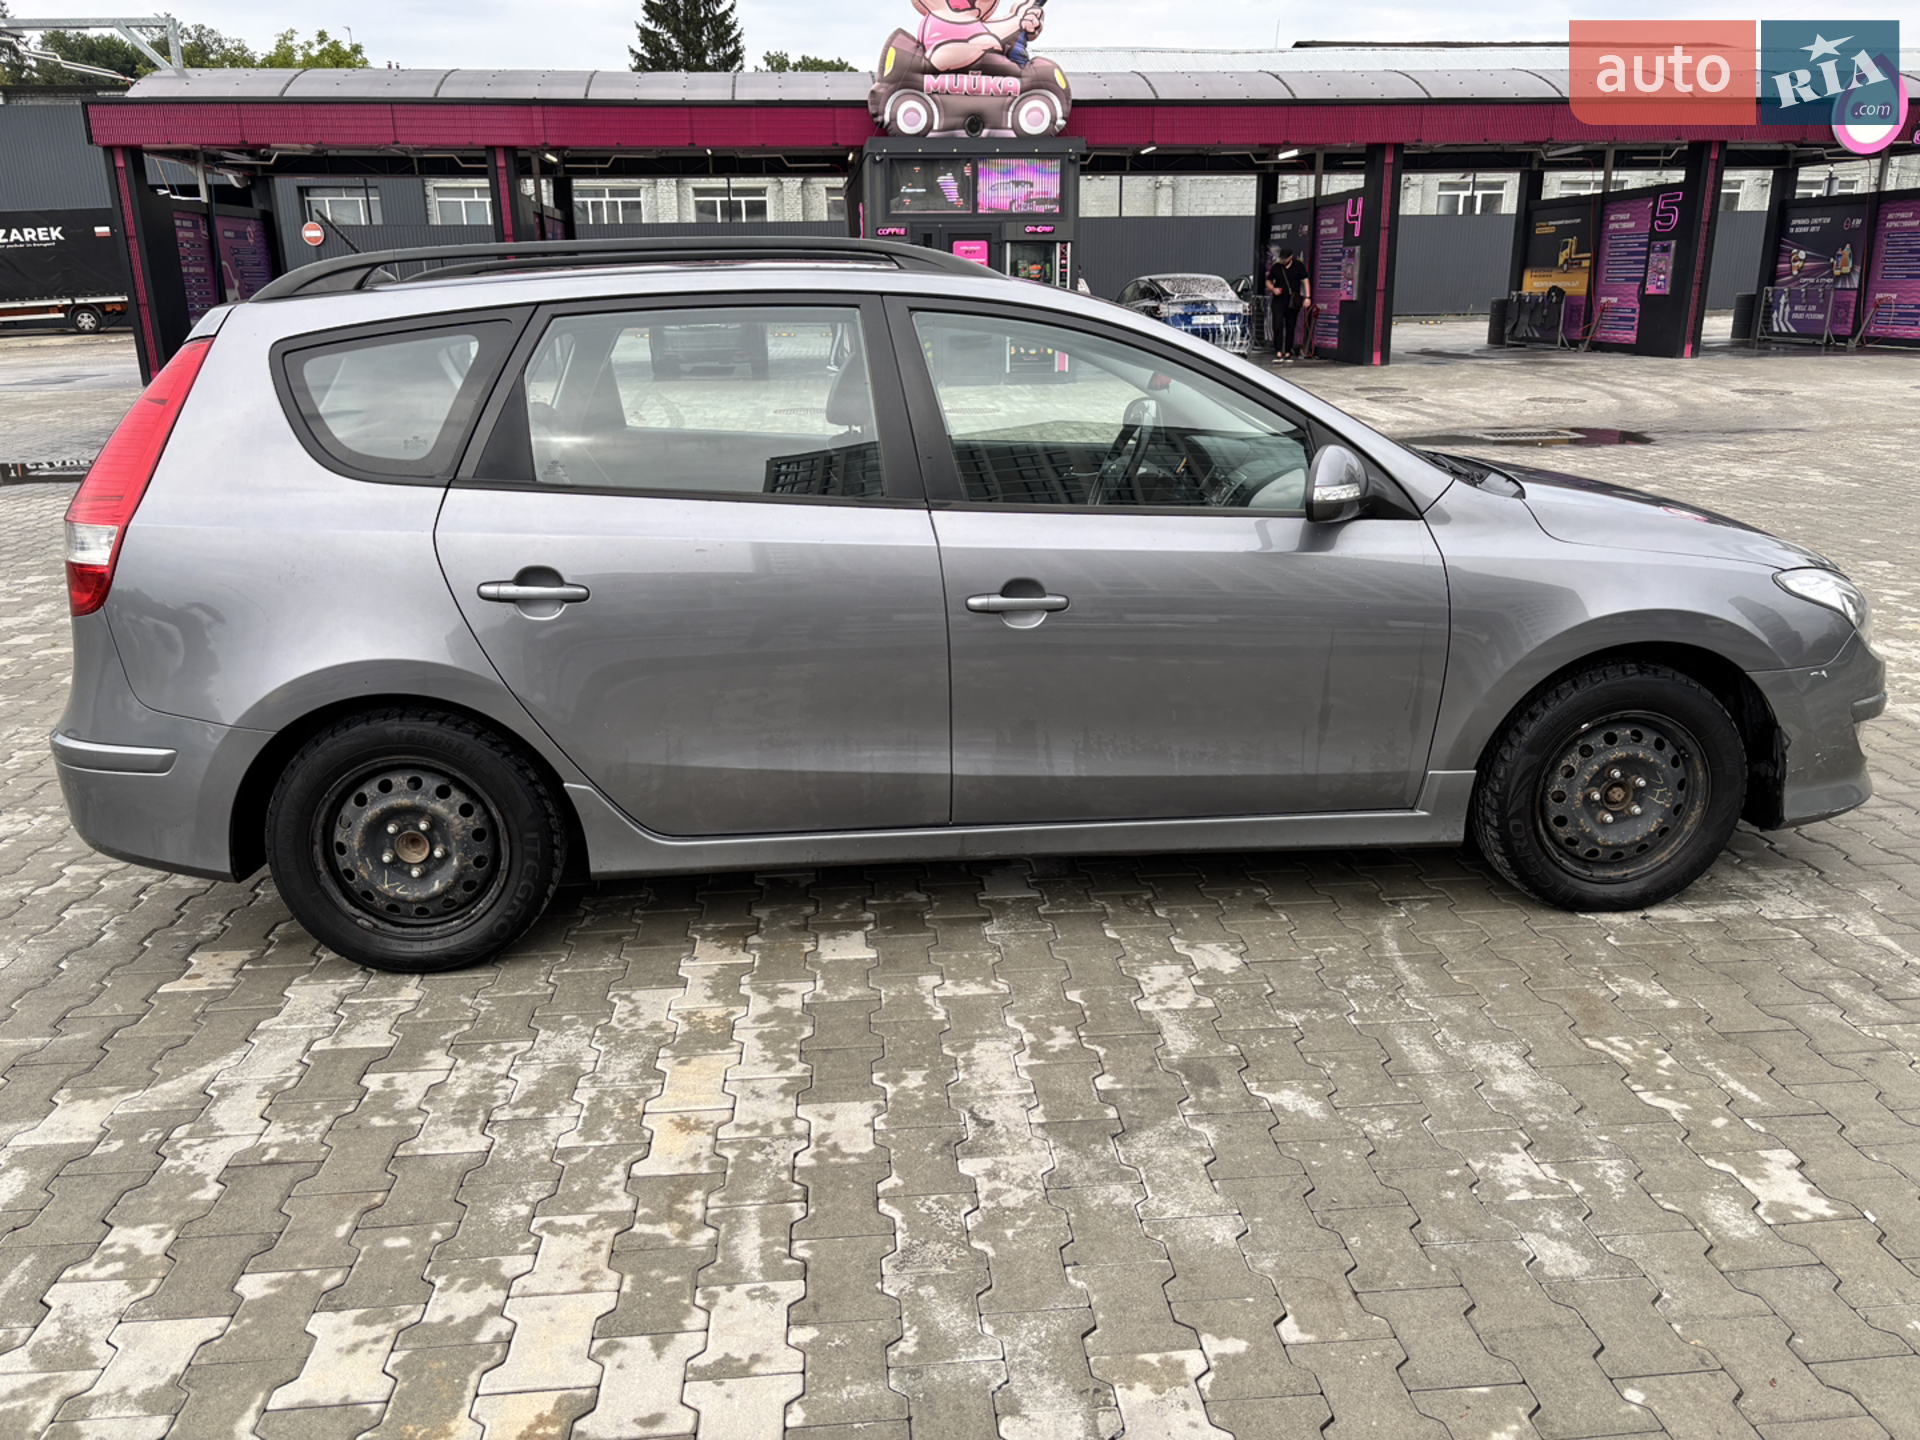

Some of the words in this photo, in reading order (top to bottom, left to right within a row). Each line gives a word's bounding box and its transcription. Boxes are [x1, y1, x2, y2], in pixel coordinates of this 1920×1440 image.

[1346, 197, 1363, 237] 4
[1654, 191, 1683, 232] 5
[0, 226, 65, 243] ZAREK
